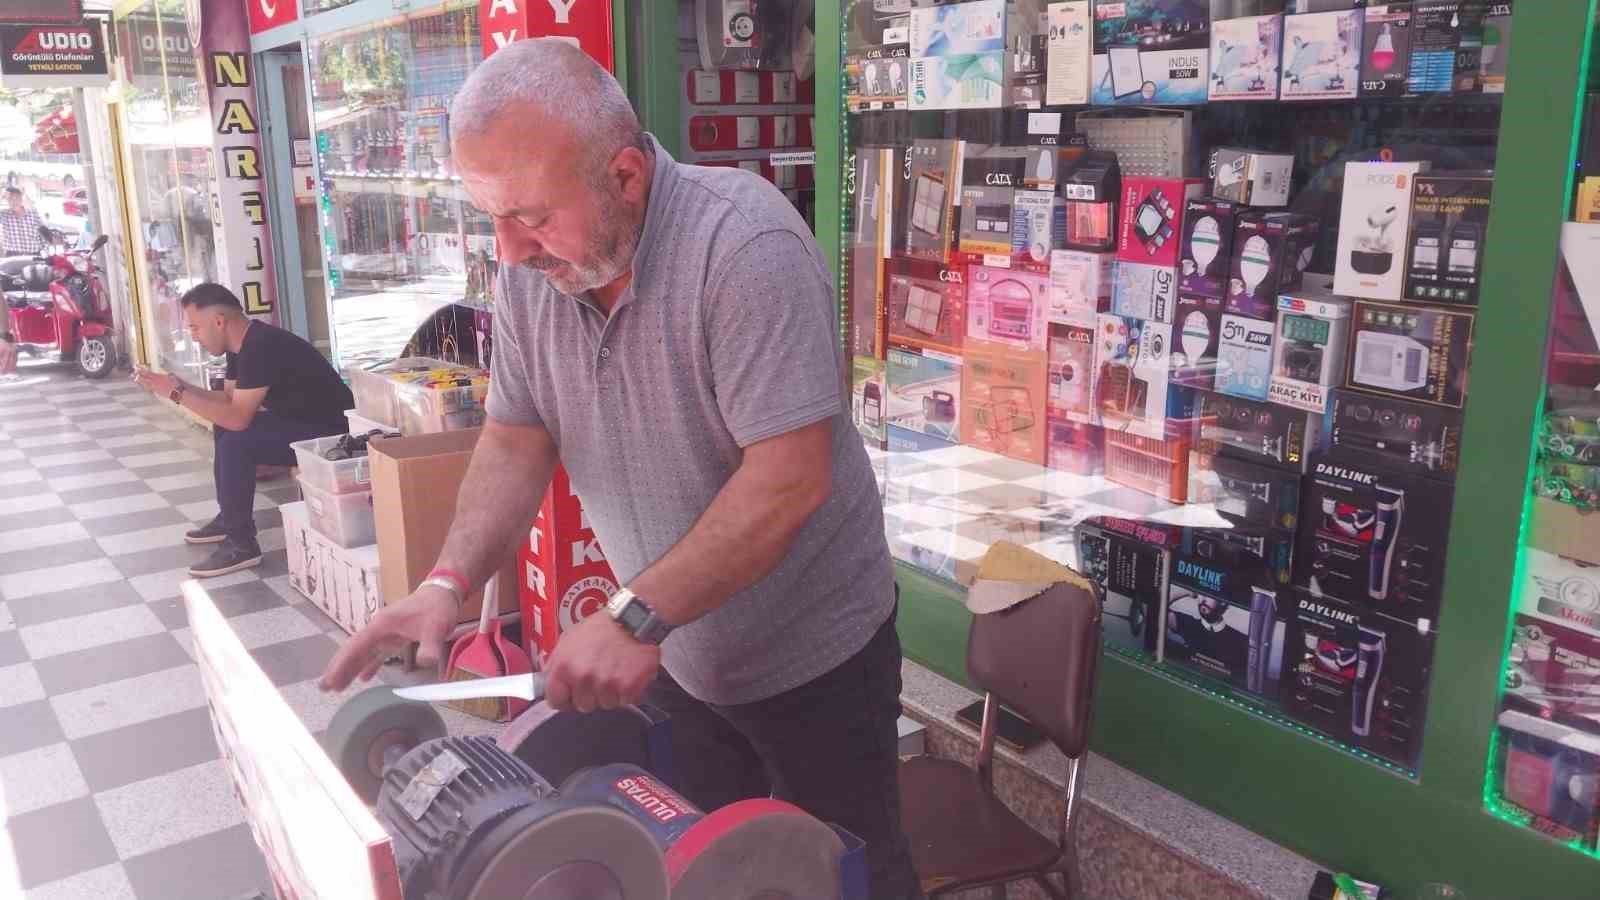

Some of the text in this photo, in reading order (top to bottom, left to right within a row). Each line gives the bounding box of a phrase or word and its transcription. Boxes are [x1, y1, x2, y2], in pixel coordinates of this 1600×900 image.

[1040, 136, 1057, 145] CATA
[903, 146, 913, 180] CATA
[847, 154, 856, 194] CATA
[986, 173, 1012, 186] CATA
[939, 269, 963, 284] CATA
[1157, 270, 1172, 299] 5m
[1068, 330, 1091, 343] CATA
[1223, 321, 1245, 340] 5m
[1270, 385, 1297, 399] ARAÇ
[1316, 463, 1374, 485] DAYLINK
[1178, 560, 1223, 587] DAYLINK
[1299, 599, 1356, 625] DAYLINK
